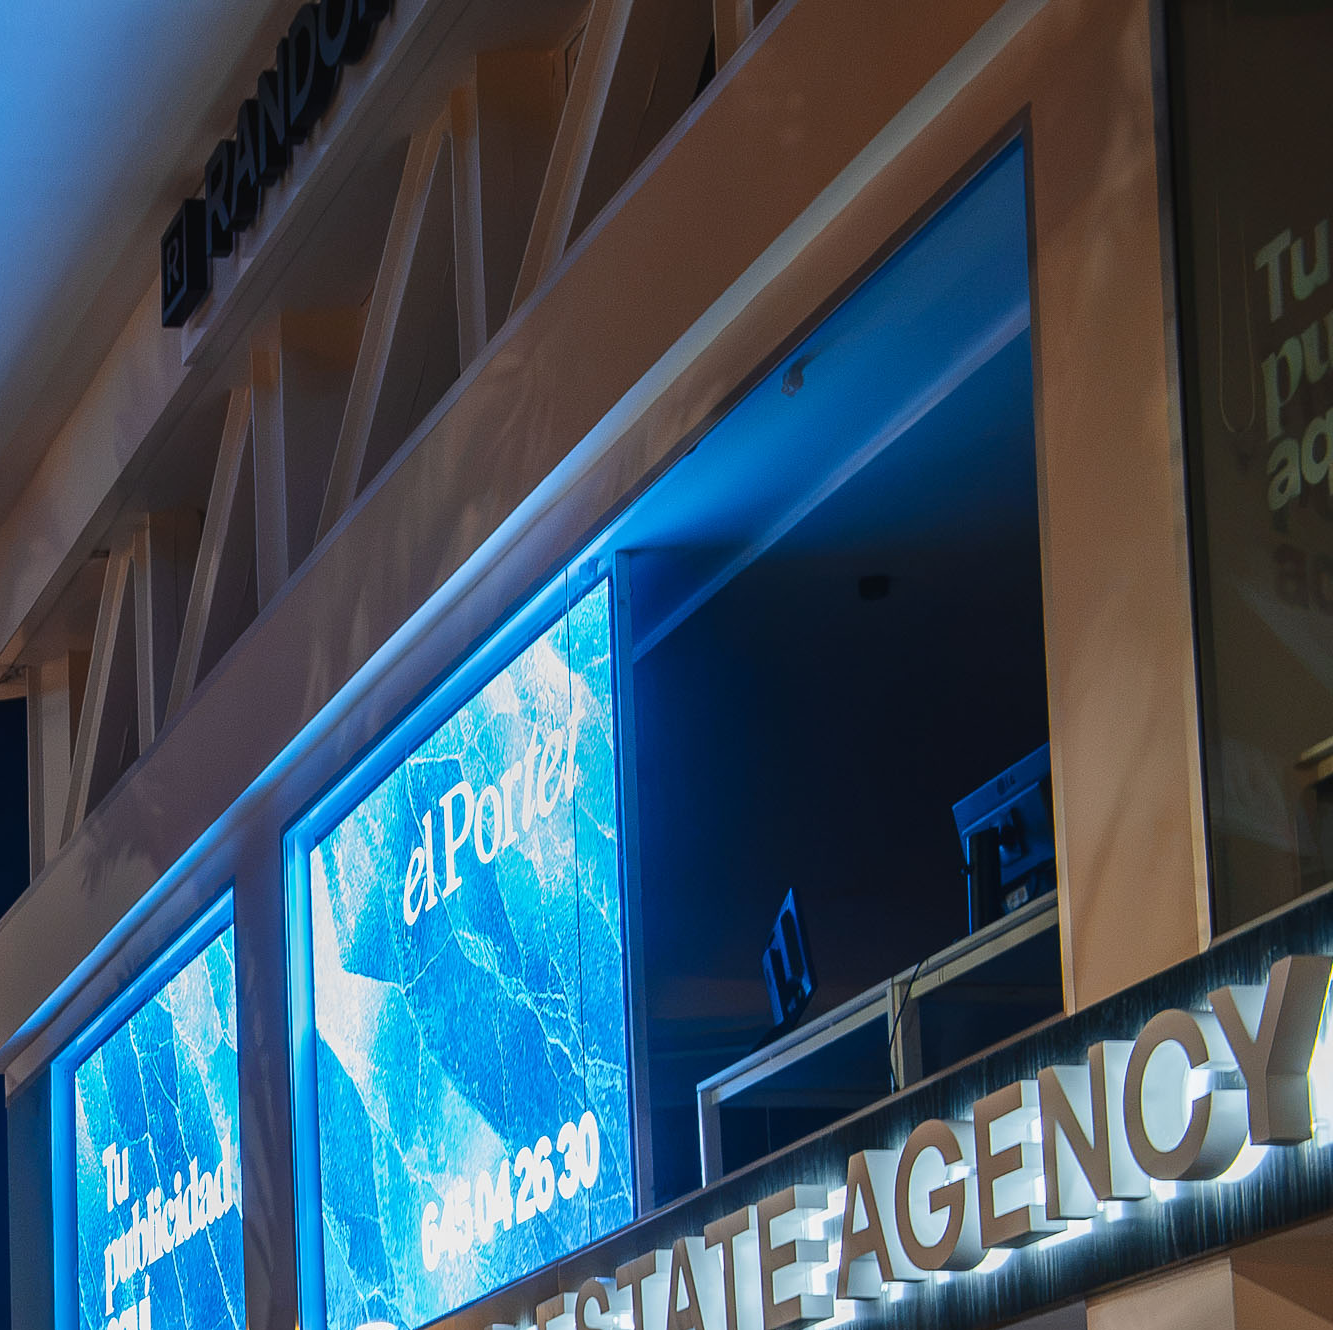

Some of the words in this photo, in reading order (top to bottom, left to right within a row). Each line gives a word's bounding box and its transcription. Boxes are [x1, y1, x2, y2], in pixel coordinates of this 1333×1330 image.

[205, 0, 366, 257] RANDO
[1254, 218, 1330, 323] Tu
[102, 1141, 129, 1213] Tu
[514, 1135, 555, 1225] 26
[556, 1110, 601, 1200] 30
[837, 955, 1301, 1300] AGENCY
[103, 1132, 234, 1317] publicidad
